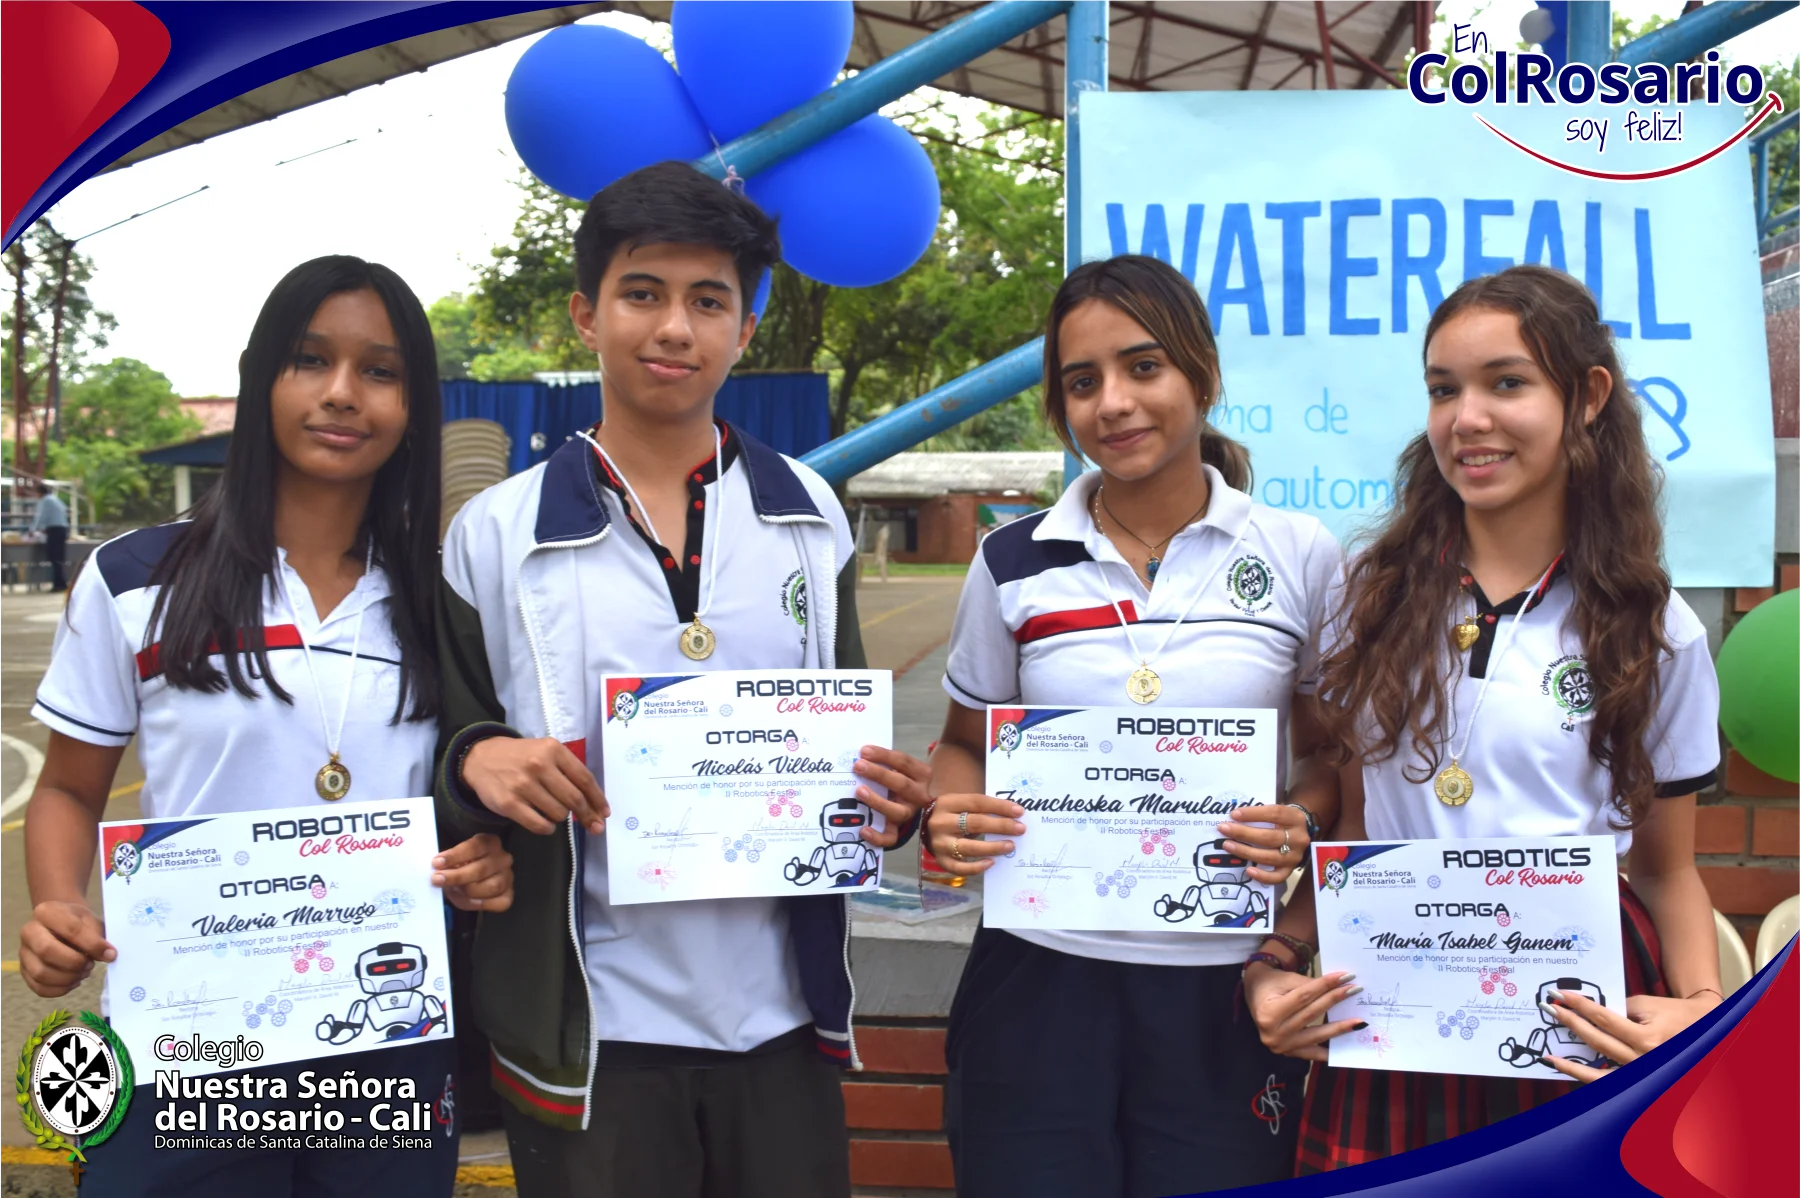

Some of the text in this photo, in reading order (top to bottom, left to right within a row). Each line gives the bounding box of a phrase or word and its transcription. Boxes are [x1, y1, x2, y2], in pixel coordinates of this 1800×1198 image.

[1105, 198, 1691, 340] WATERFALL
[1305, 387, 1348, 434] de
[1263, 465, 1395, 509] autom
[1540, 654, 1577, 696] Colegio Nuestra
[737, 679, 872, 697] ROBOTICS
[777, 697, 866, 714] Col Rosario
[1117, 718, 1255, 736] ROBOTICS
[706, 729, 798, 744] OTORGA
[1156, 736, 1248, 755] Col Rosario
[692, 756, 834, 776] Nicolás Villota
[1085, 767, 1175, 782] OTORGA
[663, 782, 697, 791] Mención
[700, 781, 710, 789] de
[713, 780, 737, 789] honor
[739, 780, 752, 788] por
[767, 778, 815, 788] participación
[733, 789, 768, 797] Robotics
[253, 810, 410, 842] ROBOTICS
[1041, 816, 1074, 824] Mención
[1089, 817, 1112, 825] honor
[1114, 818, 1127, 827] por
[1141, 817, 1191, 827] participación
[1108, 827, 1142, 835] Robotics
[186, 848, 216, 856] Señora
[299, 833, 404, 857] Col Rosario
[148, 860, 162, 868] del
[165, 857, 198, 866] Rosario
[1443, 848, 1591, 868] ROBOTICS
[220, 874, 325, 898] OTORGA
[1485, 868, 1584, 888] Col Rosario
[192, 902, 376, 936] Valeria Marrugo
[1415, 903, 1509, 917] OTORGA
[173, 943, 213, 955] Mención
[215, 941, 227, 950] de
[230, 938, 256, 947] honor
[259, 936, 275, 945] por
[290, 927, 348, 942] participación
[365, 921, 398, 931] nuestro
[1370, 931, 1574, 954] María Isabel Ganem
[253, 945, 293, 956] Robotics
[1377, 954, 1411, 962] Mención
[1425, 954, 1448, 962] honor
[1451, 956, 1465, 964] por
[1479, 955, 1530, 965] participación
